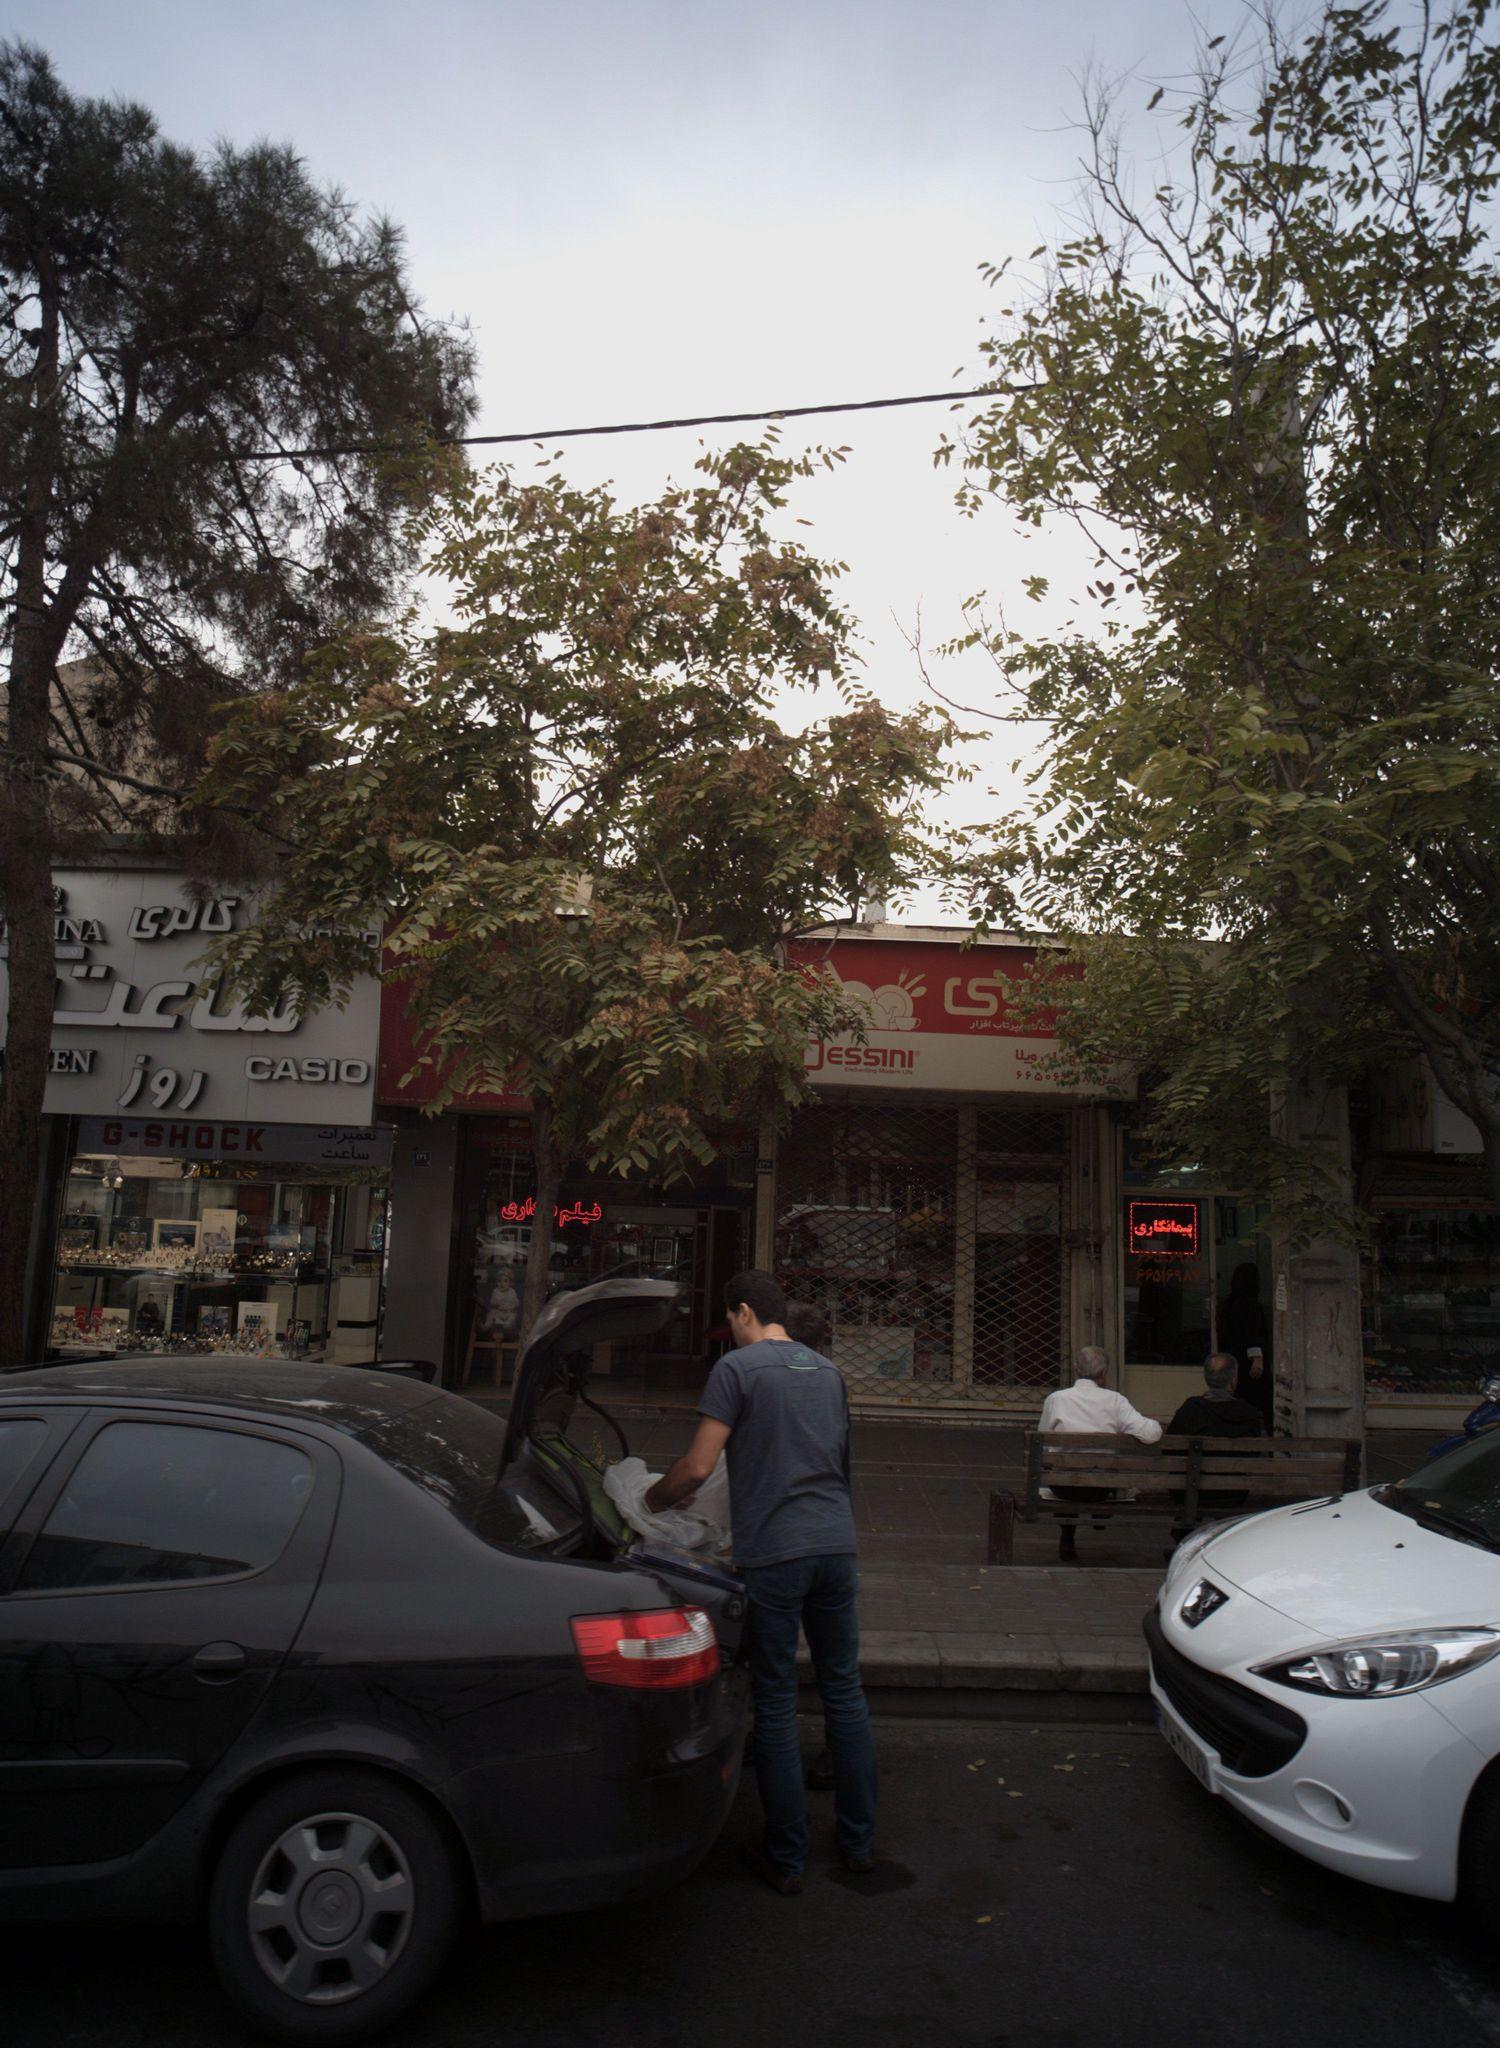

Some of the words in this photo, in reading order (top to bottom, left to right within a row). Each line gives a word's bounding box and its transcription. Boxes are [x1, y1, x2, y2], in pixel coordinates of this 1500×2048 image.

[245, 1055, 370, 1084] CASIO
[117, 1054, 207, 1112] روز
[103, 1122, 264, 1152] G-SHOCK
[318, 1128, 377, 1144] تعمیرات
[321, 1146, 369, 1160] ساعت
[1134, 1219, 1193, 1239] پیمانکاری
